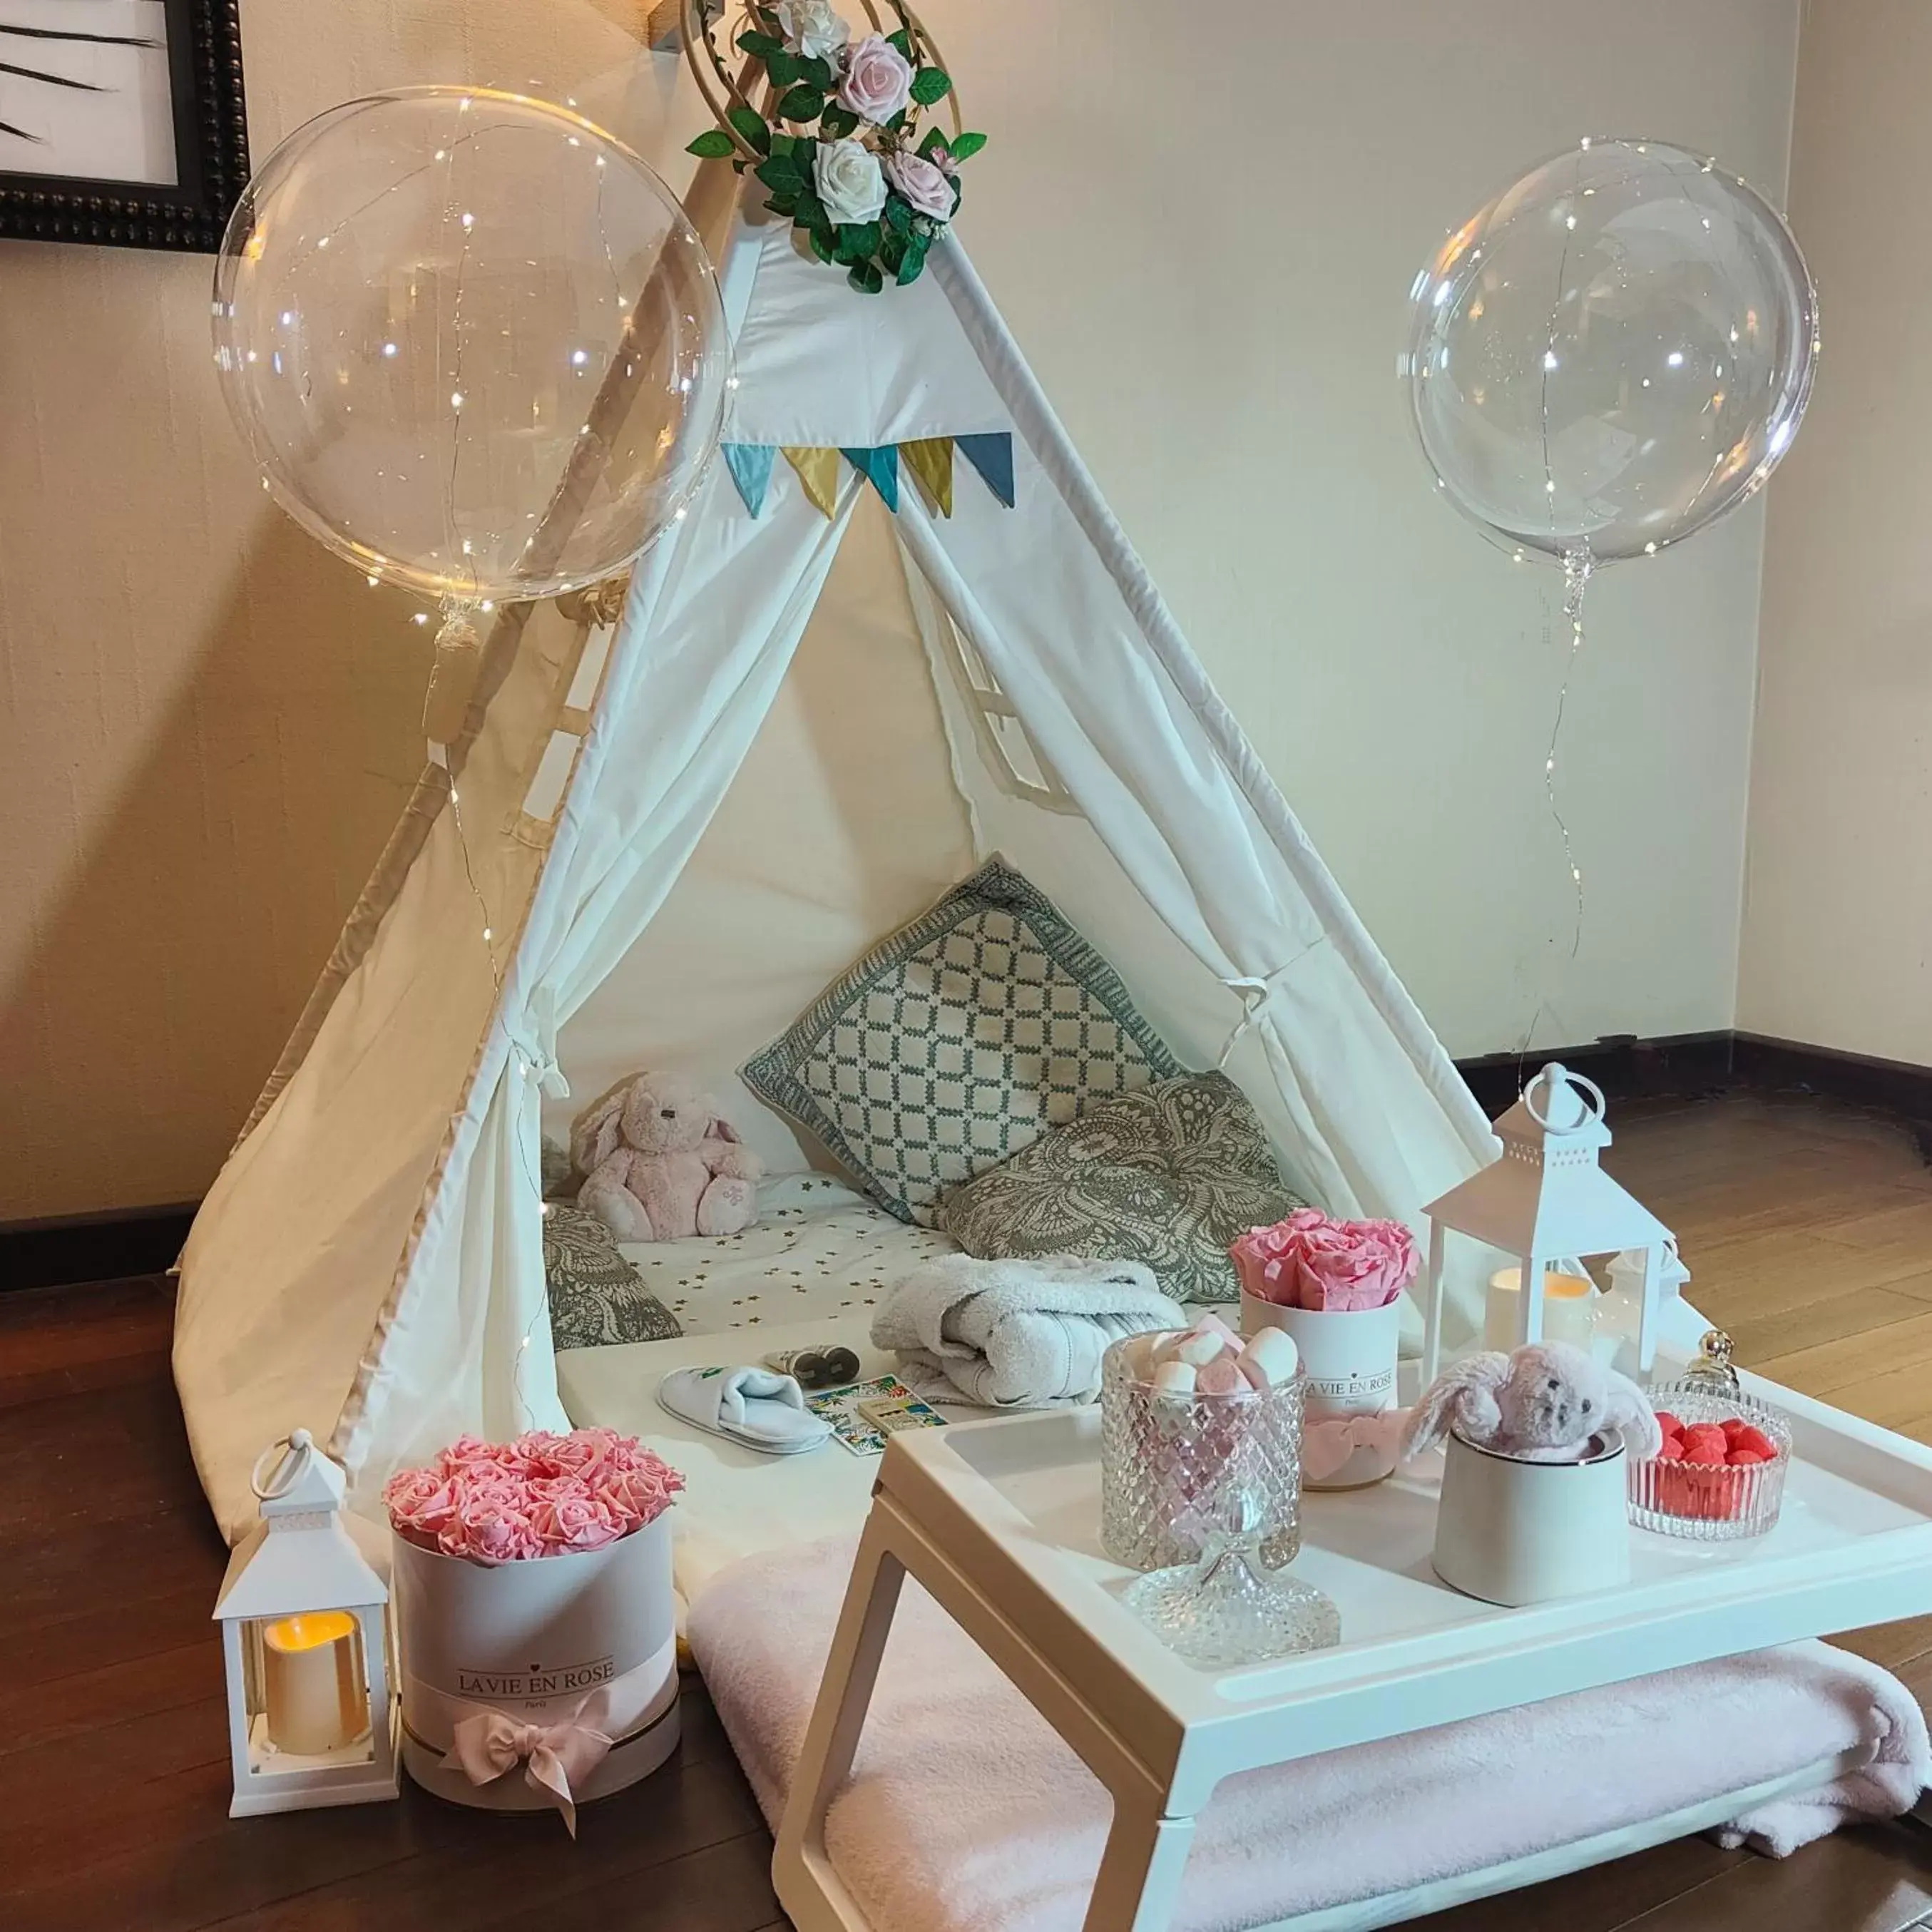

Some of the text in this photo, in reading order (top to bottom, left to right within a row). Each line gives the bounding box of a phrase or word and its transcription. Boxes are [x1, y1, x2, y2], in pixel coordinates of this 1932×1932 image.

[1305, 1382, 1316, 1393] A
[1319, 1382, 1345, 1394] VIE
[1349, 1381, 1366, 1394] EN
[459, 1662, 615, 1694] LA VIE EN ROSE
